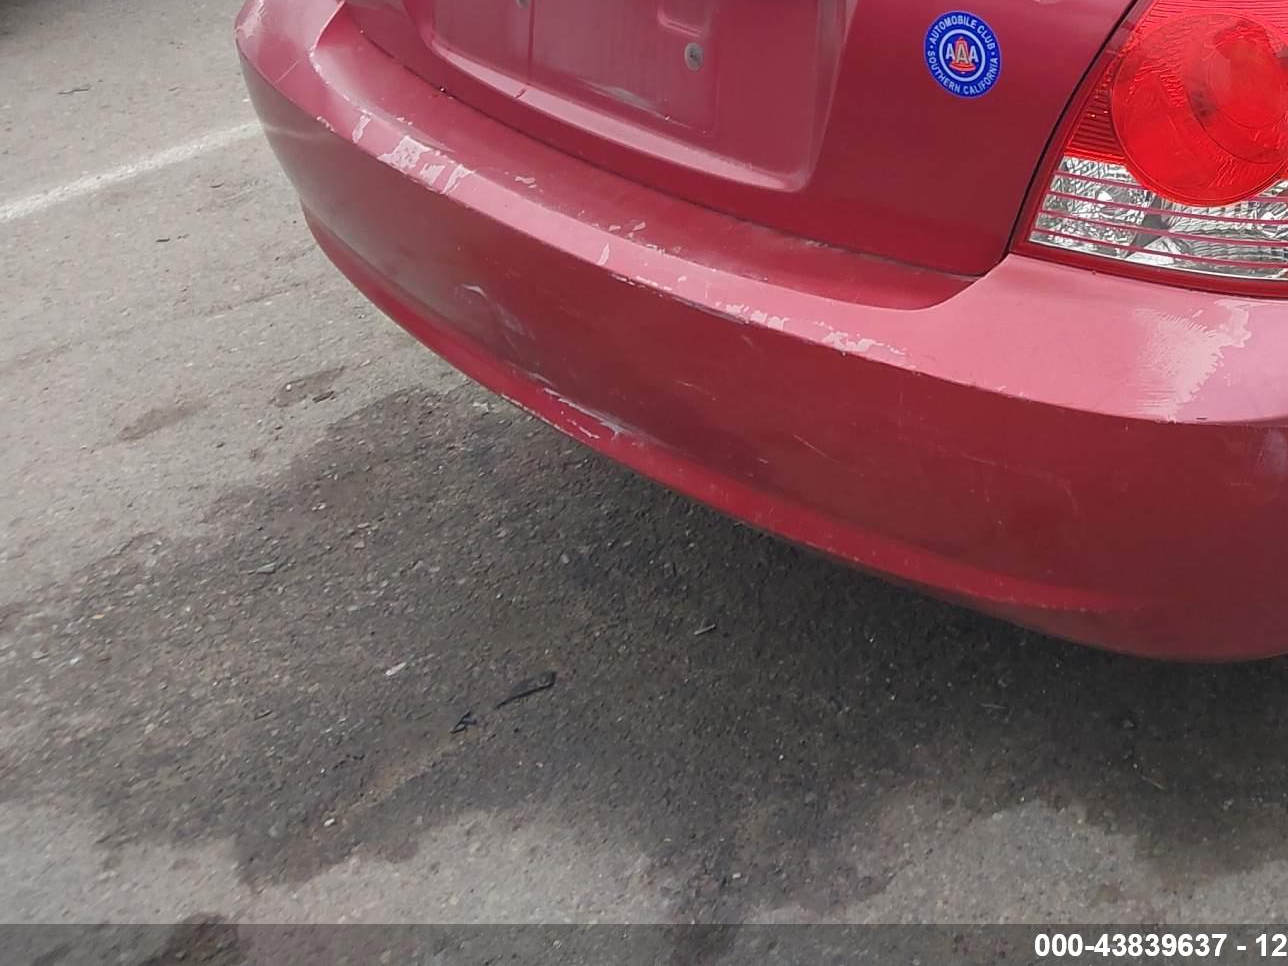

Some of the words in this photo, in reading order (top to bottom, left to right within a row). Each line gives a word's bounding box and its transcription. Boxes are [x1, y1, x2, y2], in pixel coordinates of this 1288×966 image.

[929, 15, 977, 45] AUTOMOBILE
[977, 25, 996, 50] CLUB
[945, 43, 979, 64] AAA
[927, 50, 961, 94] SOUTHERN
[963, 57, 999, 95] CALIFORNIA
